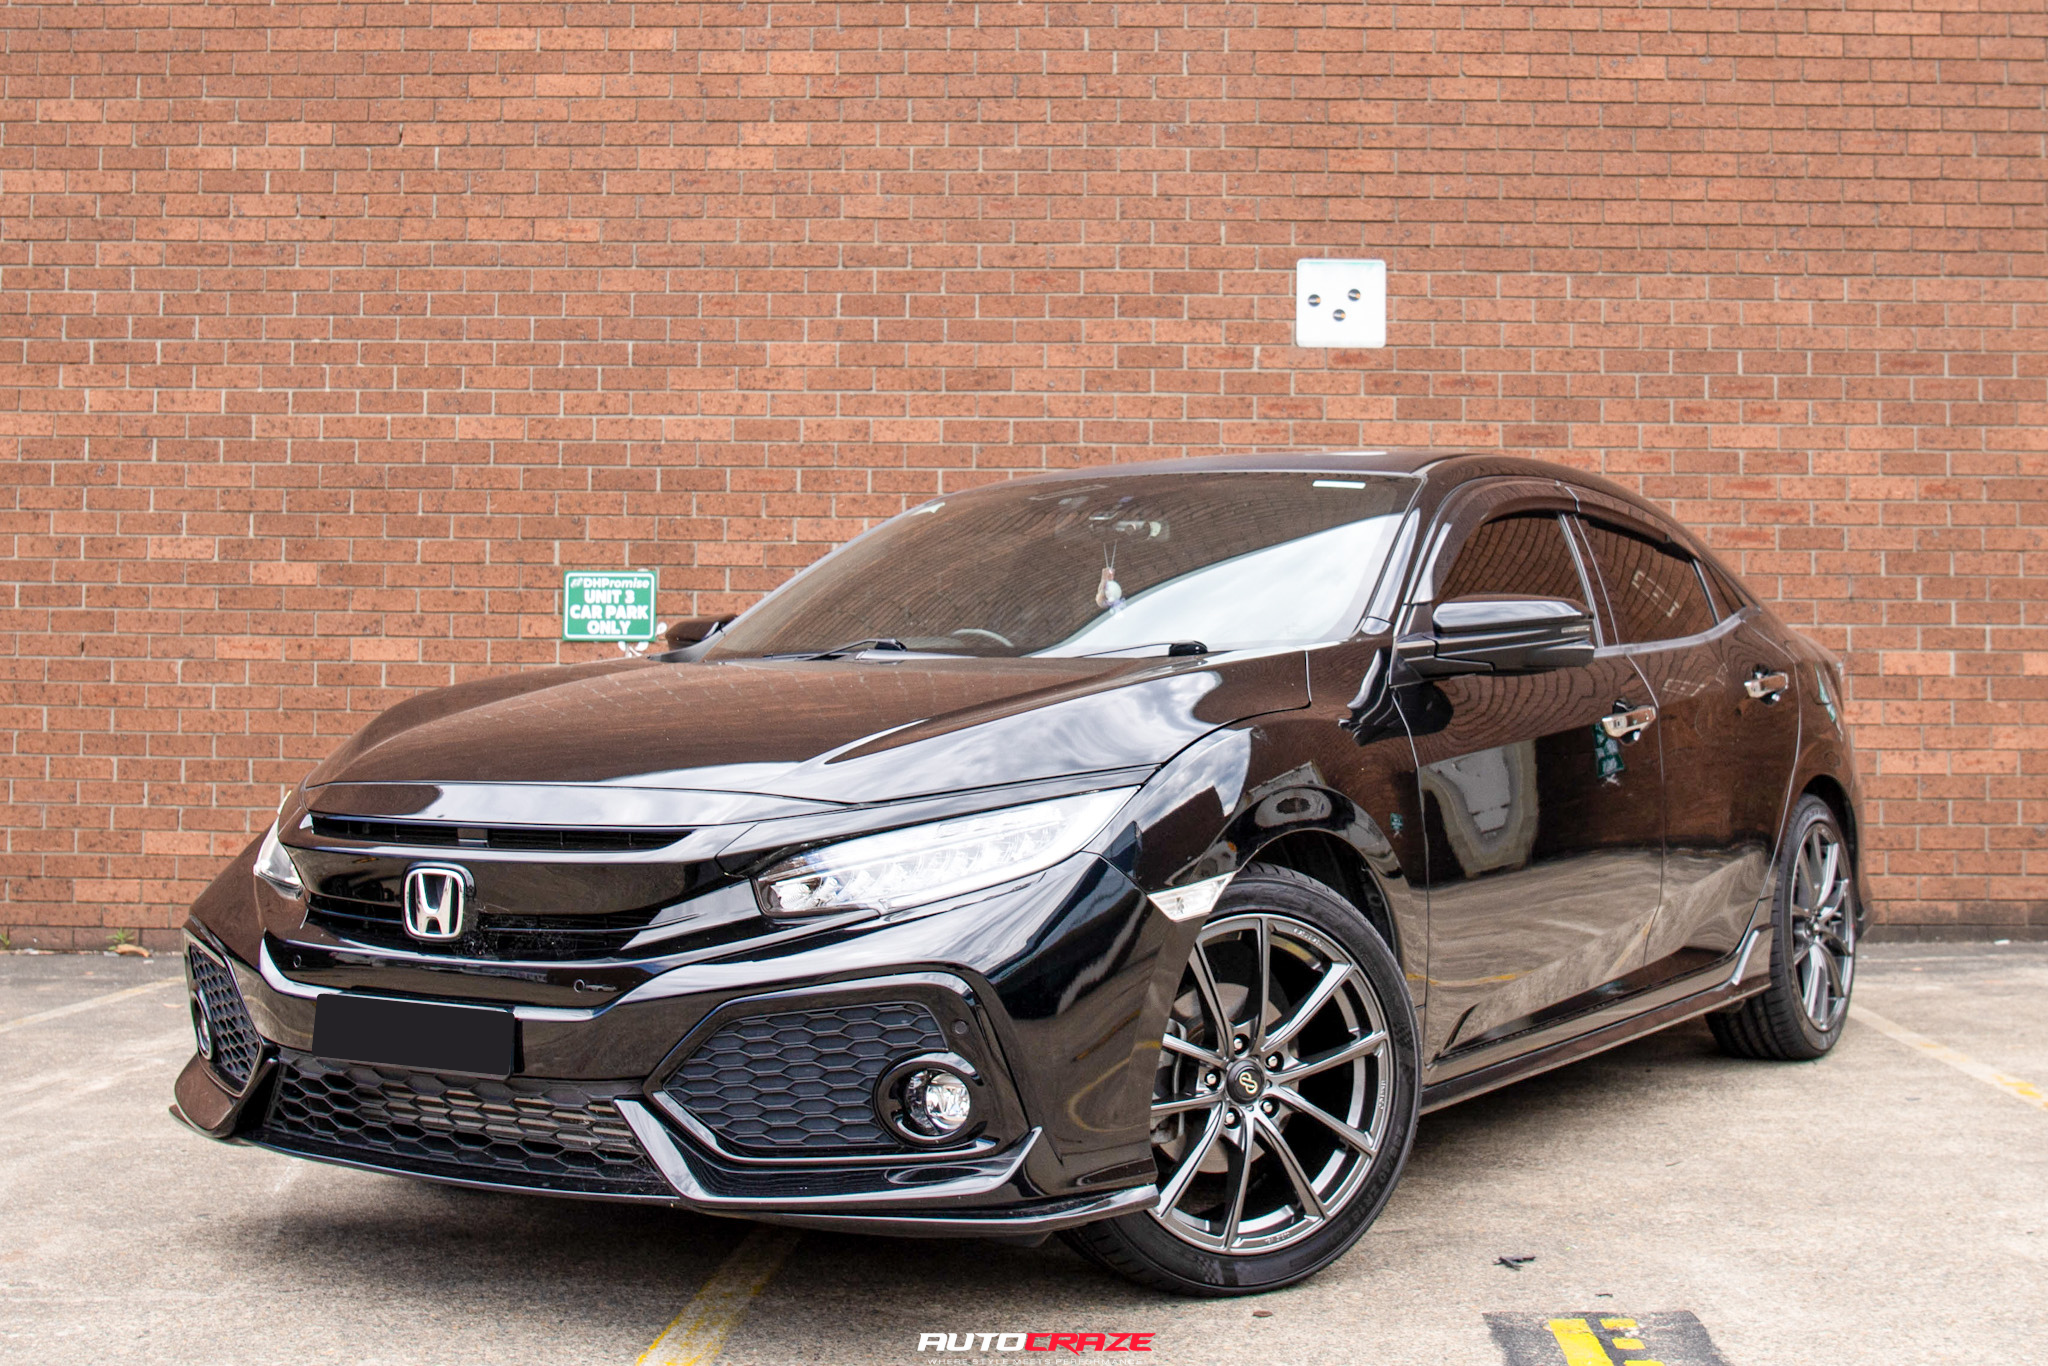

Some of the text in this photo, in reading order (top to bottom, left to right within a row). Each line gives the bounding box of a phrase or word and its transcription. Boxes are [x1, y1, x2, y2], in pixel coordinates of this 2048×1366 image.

[584, 589, 636, 604] UNIT 3
[569, 604, 649, 620] CAR PARK
[586, 620, 631, 635] ONLY
